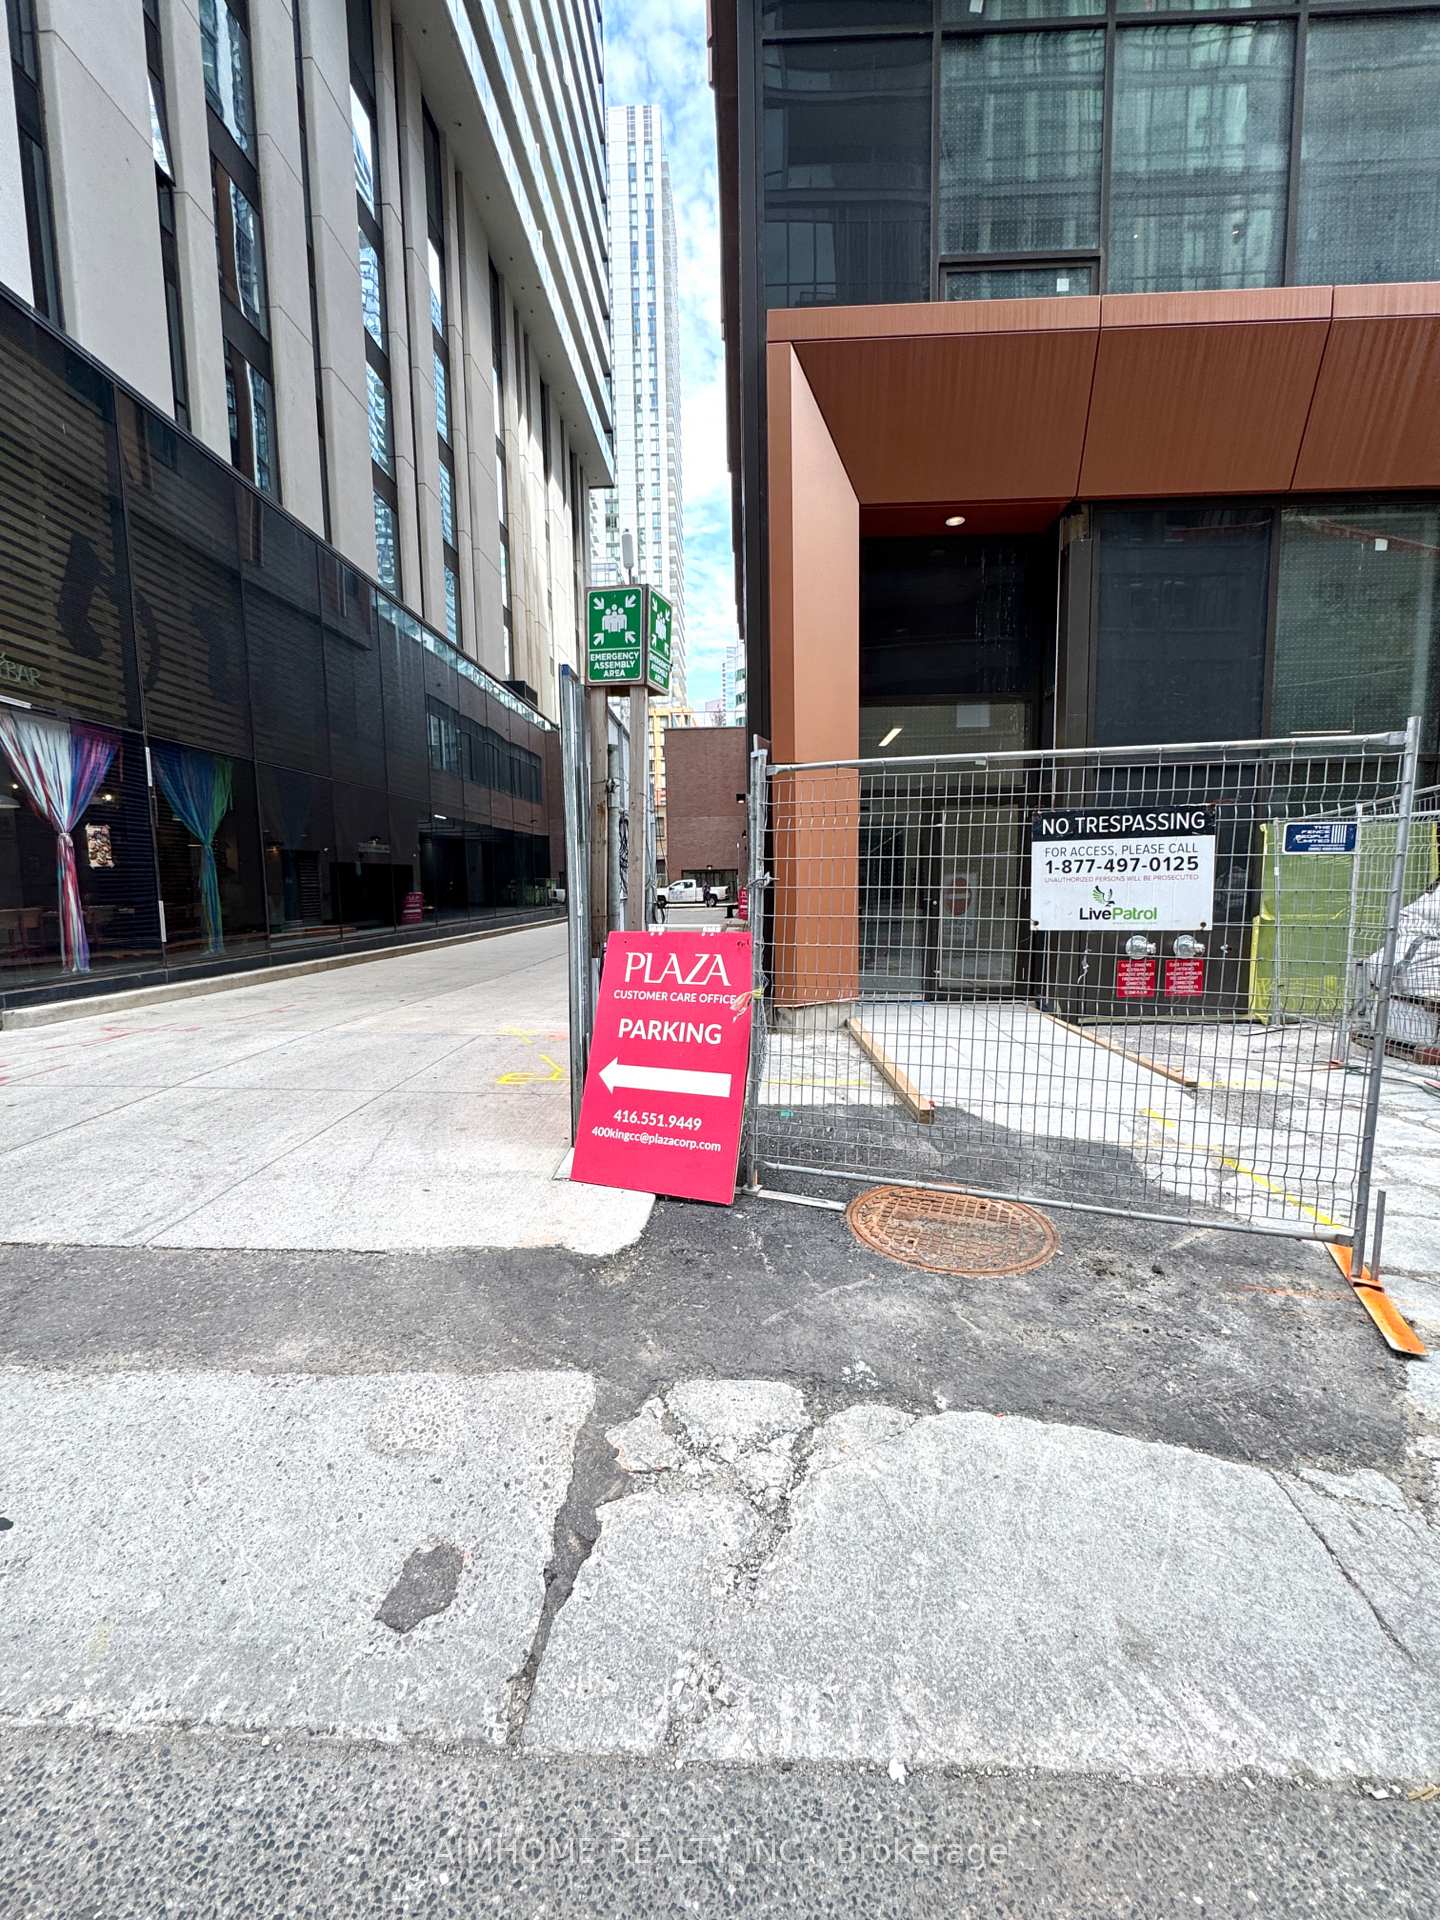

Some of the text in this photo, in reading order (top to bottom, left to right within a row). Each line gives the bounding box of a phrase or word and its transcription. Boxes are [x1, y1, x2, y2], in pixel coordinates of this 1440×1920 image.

[590, 651, 639, 661] EMERGENCY
[594, 660, 636, 670] ASSEMBLY
[603, 669, 626, 677] AREA
[1042, 811, 1205, 835] NO TRESPASSING
[1045, 842, 1199, 857] FOR ACCESS, PLEASE CALL
[1045, 856, 1199, 874] 1-877-497-0125
[1153, 873, 1200, 881] PROSECUTED
[1079, 907, 1157, 920] LivePatrol
[624, 952, 732, 986] PLAZA
[613, 989, 737, 1005] CUSTOMER CARE OFFICE
[618, 1018, 722, 1044] PARKING
[613, 1109, 702, 1131] 416.551.9449
[591, 1126, 721, 1152] 400kingcc@plazacorp.com
